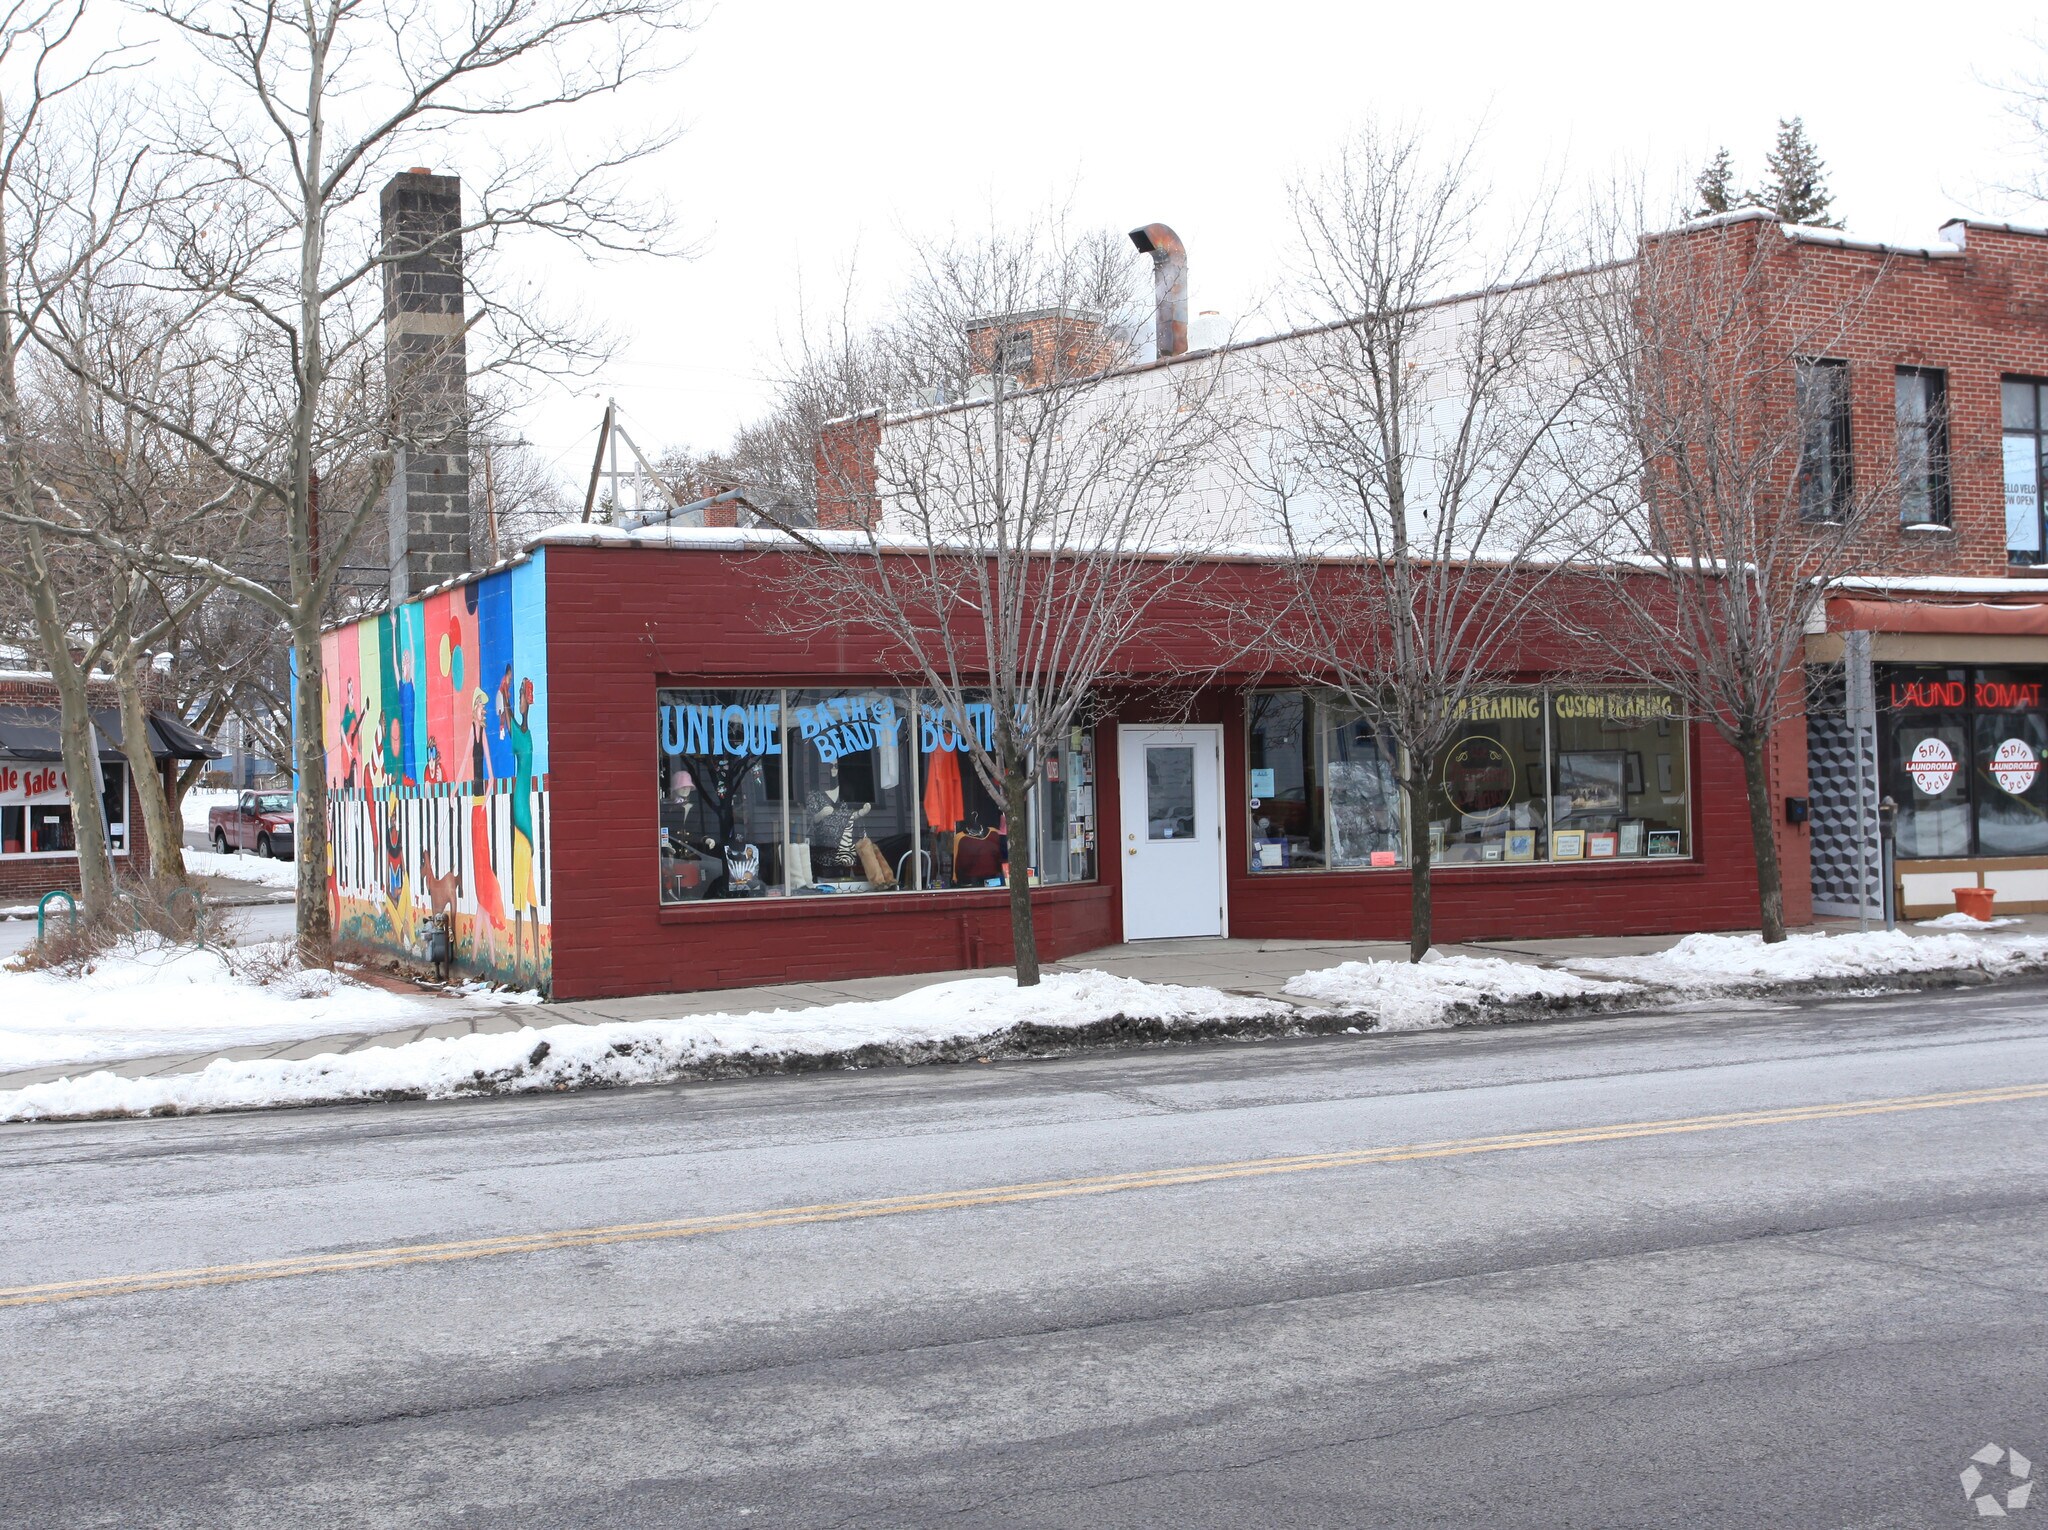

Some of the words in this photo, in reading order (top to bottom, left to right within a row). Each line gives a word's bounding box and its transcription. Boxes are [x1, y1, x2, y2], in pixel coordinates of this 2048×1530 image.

[2004, 483, 2018, 493] ELLO
[2020, 484, 2036, 494] VELO
[2005, 495, 2014, 505] OW
[2016, 495, 2034, 506] OPEN
[1471, 694, 1540, 720] FRAMING
[1556, 694, 1604, 719] CUSTOM
[795, 697, 868, 740] BATH
[660, 704, 782, 758] UNIQUE
[813, 717, 906, 763] BEAUTY
[1919, 743, 1946, 759] Spin
[2001, 743, 2027, 759] Spin
[1906, 762, 1957, 771] LAUNDROMAT
[1989, 762, 2039, 771] LAUNDROMAT
[24, 767, 57, 798] Sale
[1917, 772, 1950, 792] Cycle
[2000, 772, 2031, 792] Cycle
